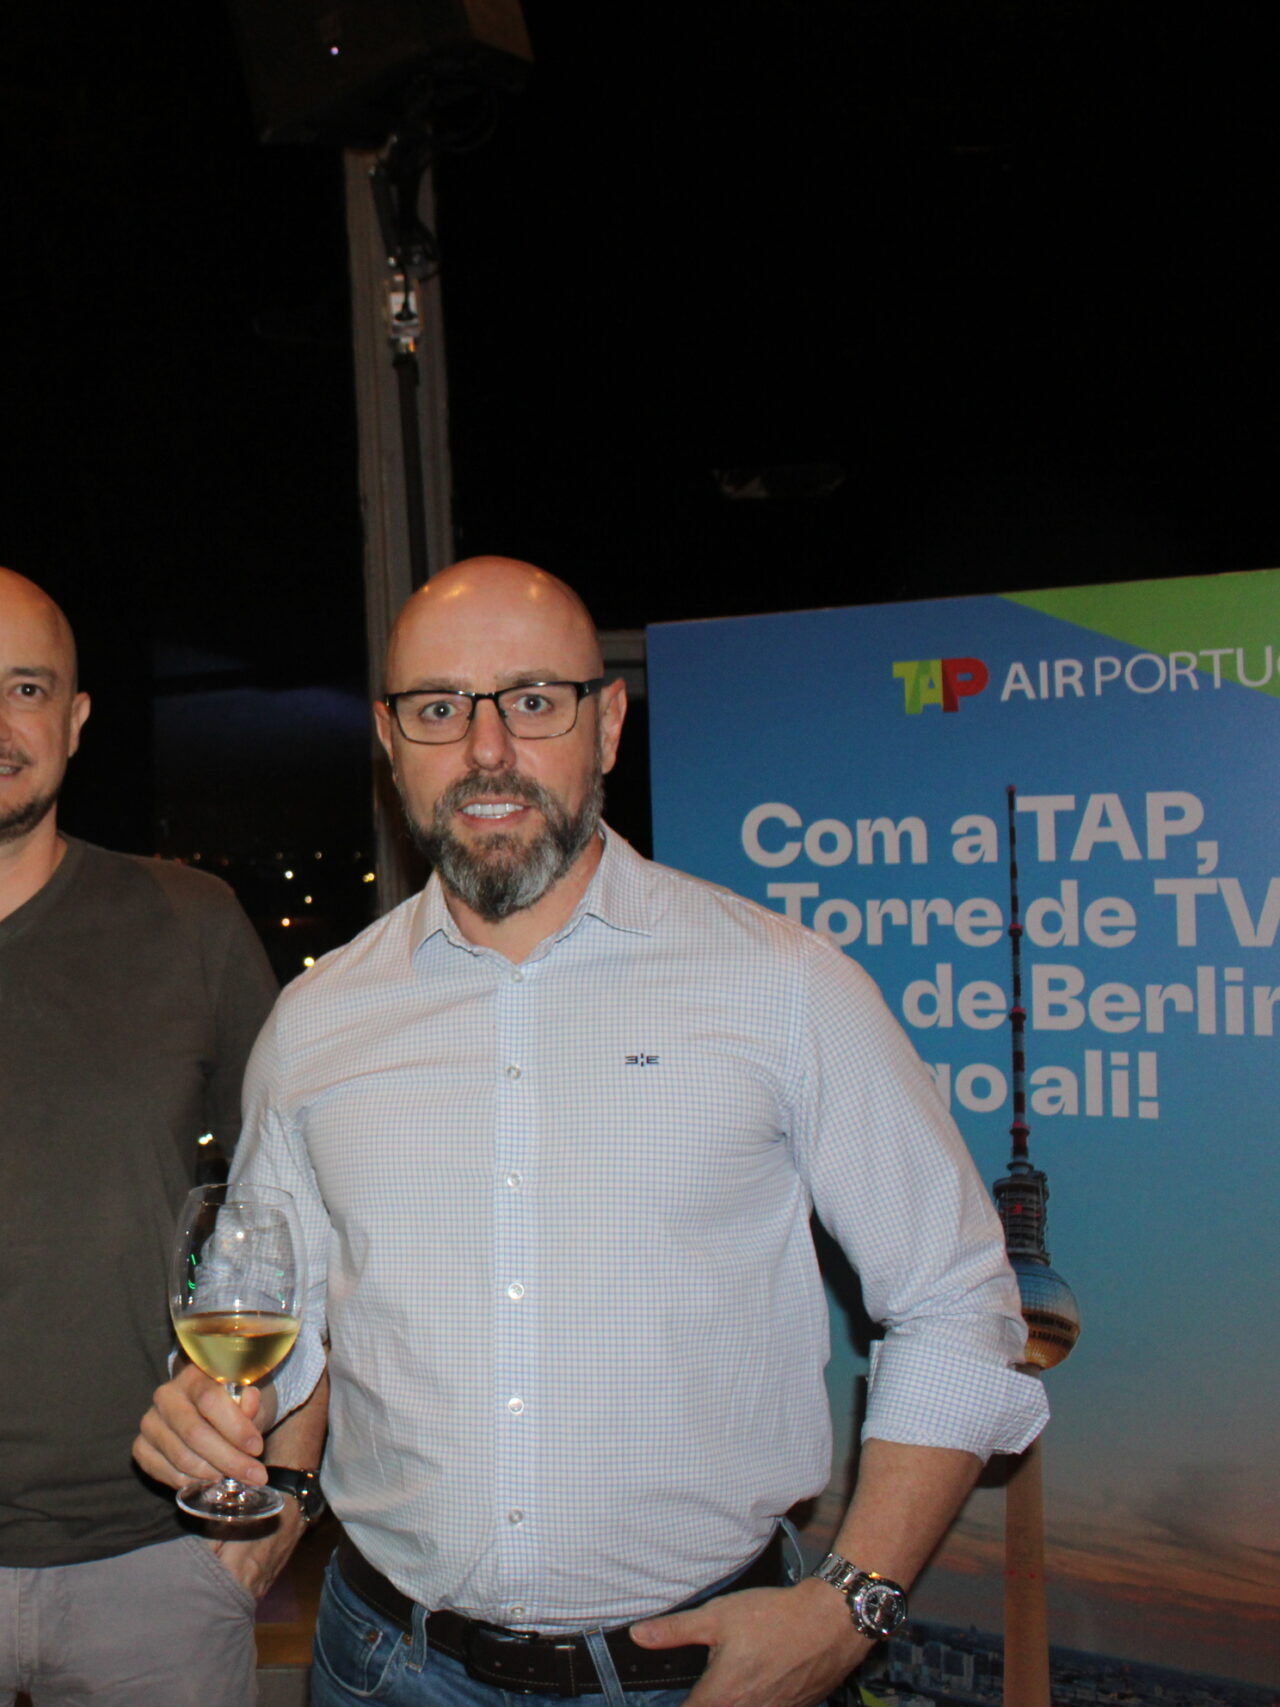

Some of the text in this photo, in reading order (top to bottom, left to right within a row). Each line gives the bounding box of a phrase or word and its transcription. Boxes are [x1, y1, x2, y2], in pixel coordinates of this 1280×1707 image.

[892, 657, 989, 715] TAP
[741, 791, 1219, 875] Com a TAP,
[767, 878, 1280, 948] Torre de TV
[903, 963, 1007, 1029] de
[1030, 1050, 1159, 1119] ali!
